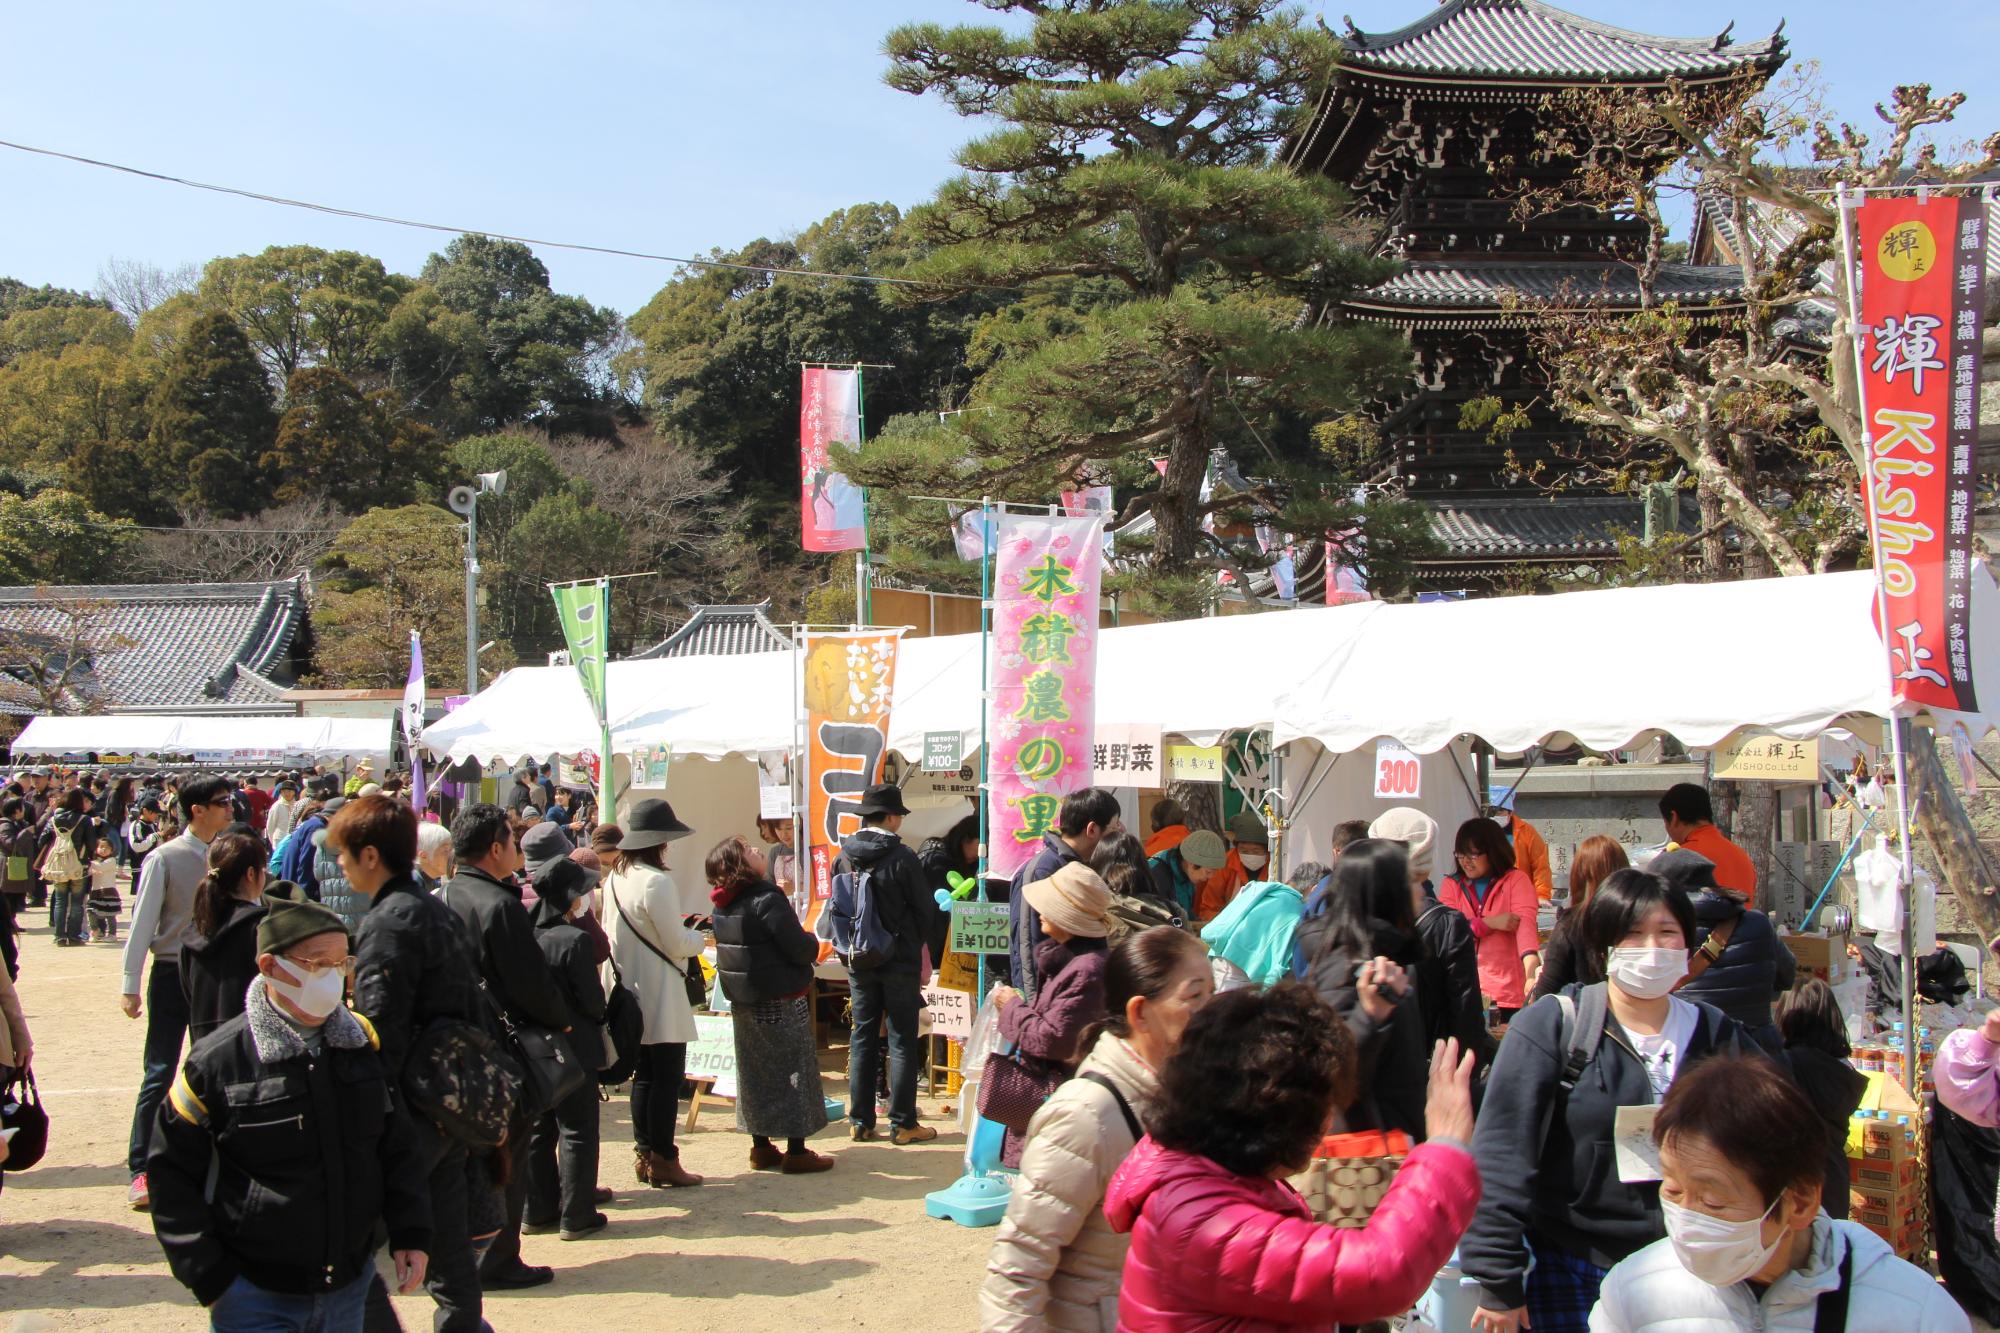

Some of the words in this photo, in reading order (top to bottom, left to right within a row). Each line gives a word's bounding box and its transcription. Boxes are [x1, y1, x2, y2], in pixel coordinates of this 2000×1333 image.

[1872, 312, 1946, 395] 輝
[846, 639, 870, 716] おいしい
[1012, 553, 1078, 844] 木積農の里
[932, 744, 953, 752] コロッケ
[813, 850, 831, 897] 味自慢
[962, 916, 1009, 931] ドーナツ
[965, 934, 1009, 949] ¥100
[927, 993, 962, 1008] 揚げたて
